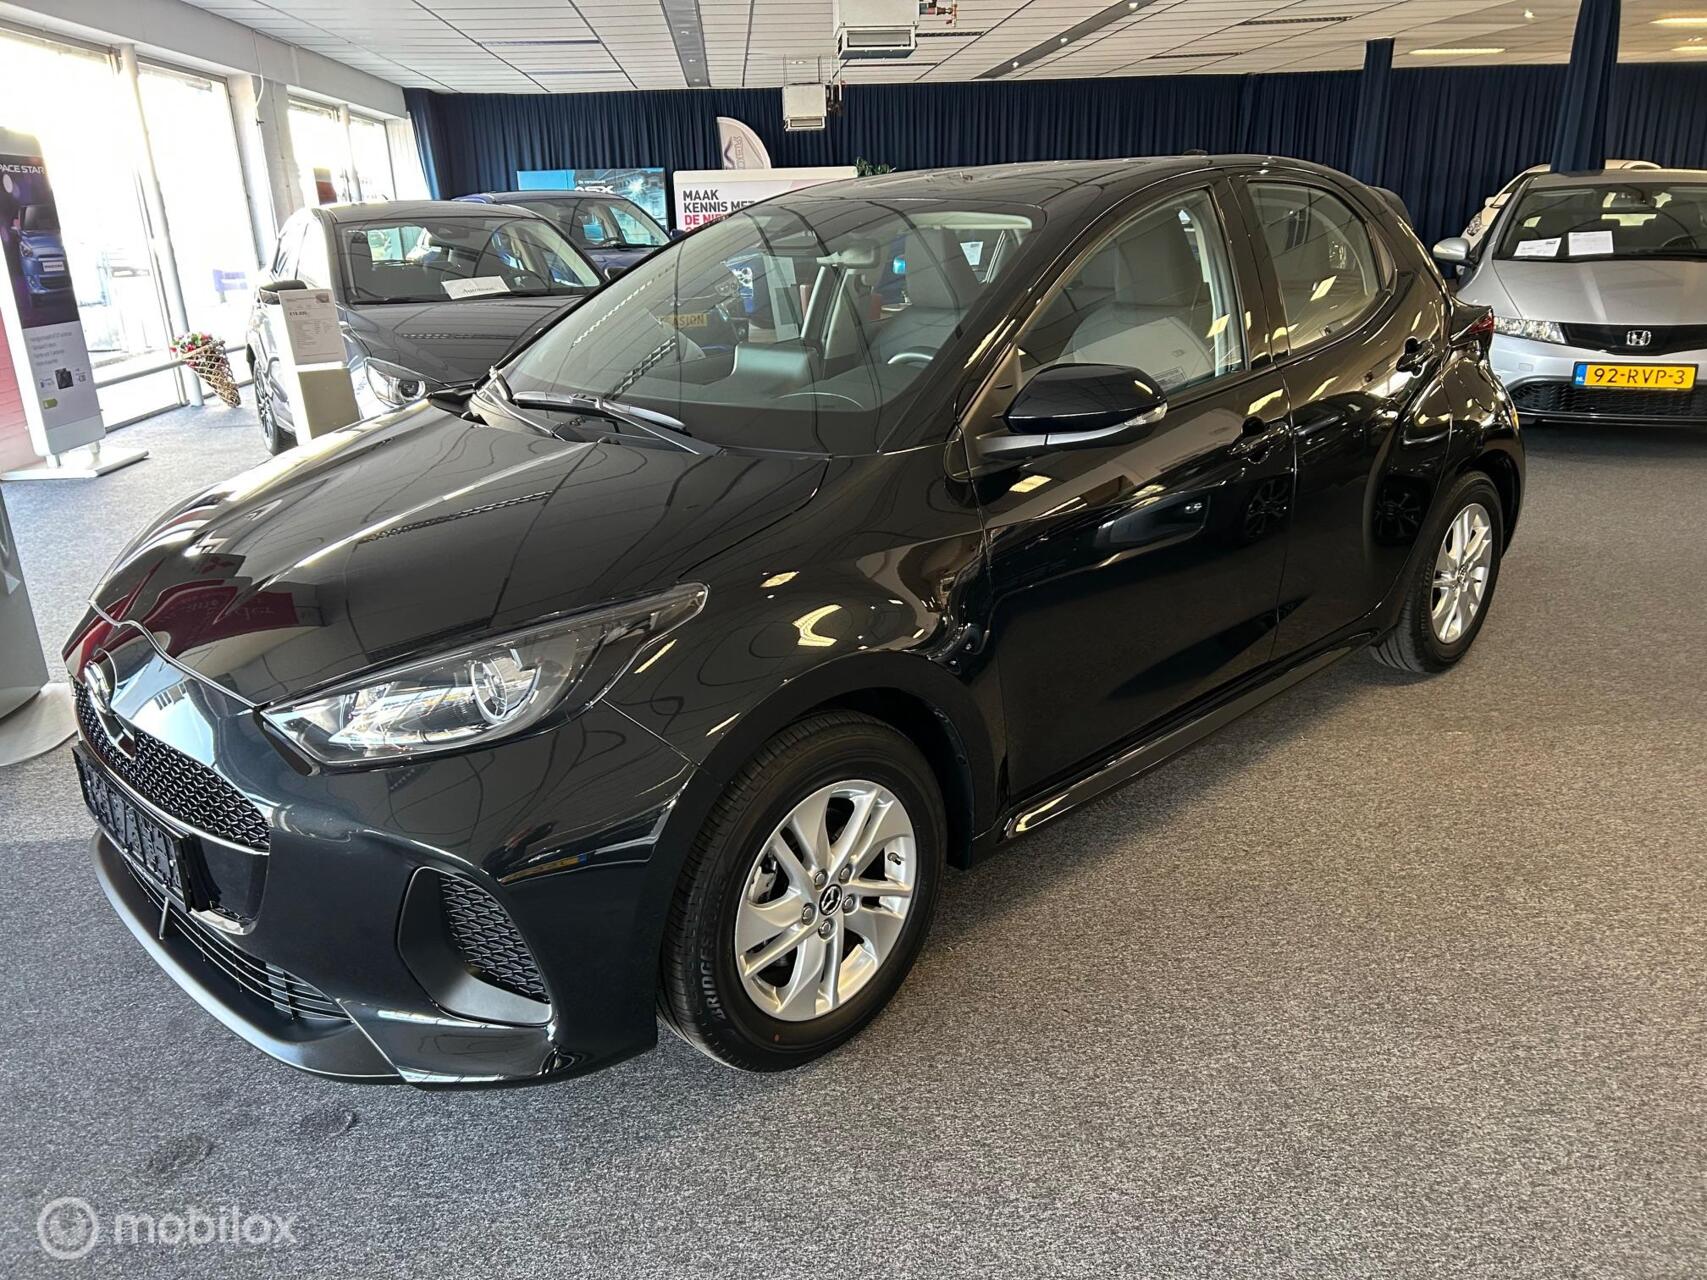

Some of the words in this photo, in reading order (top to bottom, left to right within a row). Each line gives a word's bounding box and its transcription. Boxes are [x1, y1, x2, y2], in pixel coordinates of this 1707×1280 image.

[21, 165, 46, 175] STAR
[683, 189, 719, 202] MAAK
[684, 201, 728, 214] KENNIS
[731, 200, 755, 212] ME
[685, 214, 700, 226] DE
[1594, 367, 1686, 385] 92-RVP-3
